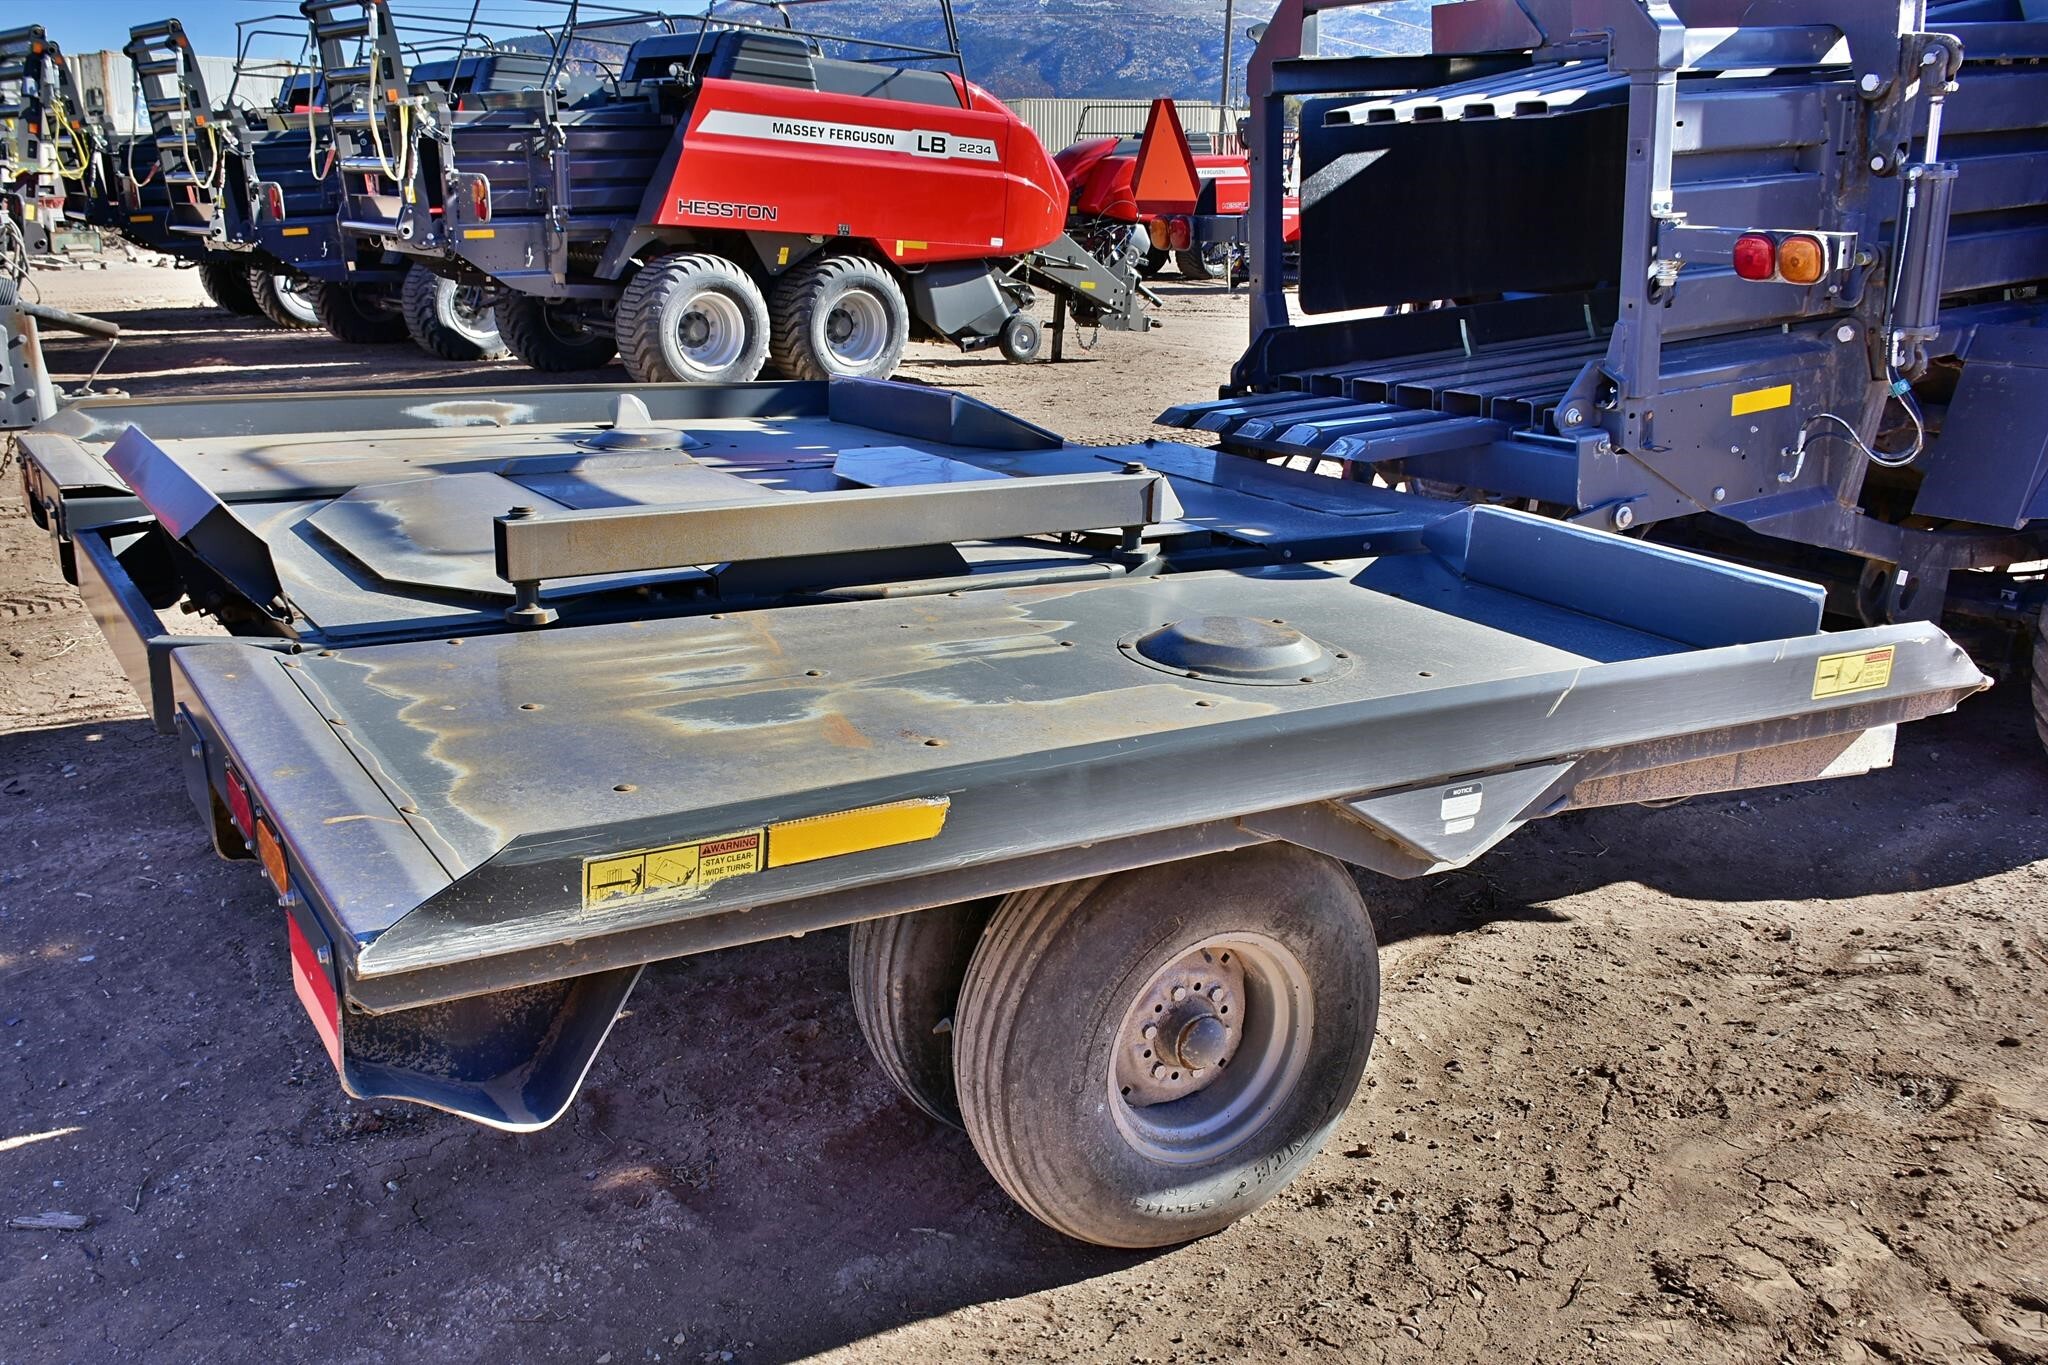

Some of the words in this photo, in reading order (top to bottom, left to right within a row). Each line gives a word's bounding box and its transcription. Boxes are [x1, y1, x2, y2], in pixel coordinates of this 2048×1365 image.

[772, 122, 826, 138] MASSEY
[829, 128, 895, 146] FERGUSON
[917, 135, 946, 153] LB
[958, 143, 991, 154] 2234
[678, 198, 777, 221] HESSTON
[1453, 786, 1473, 795] NOTICE
[711, 837, 756, 852] WARNING
